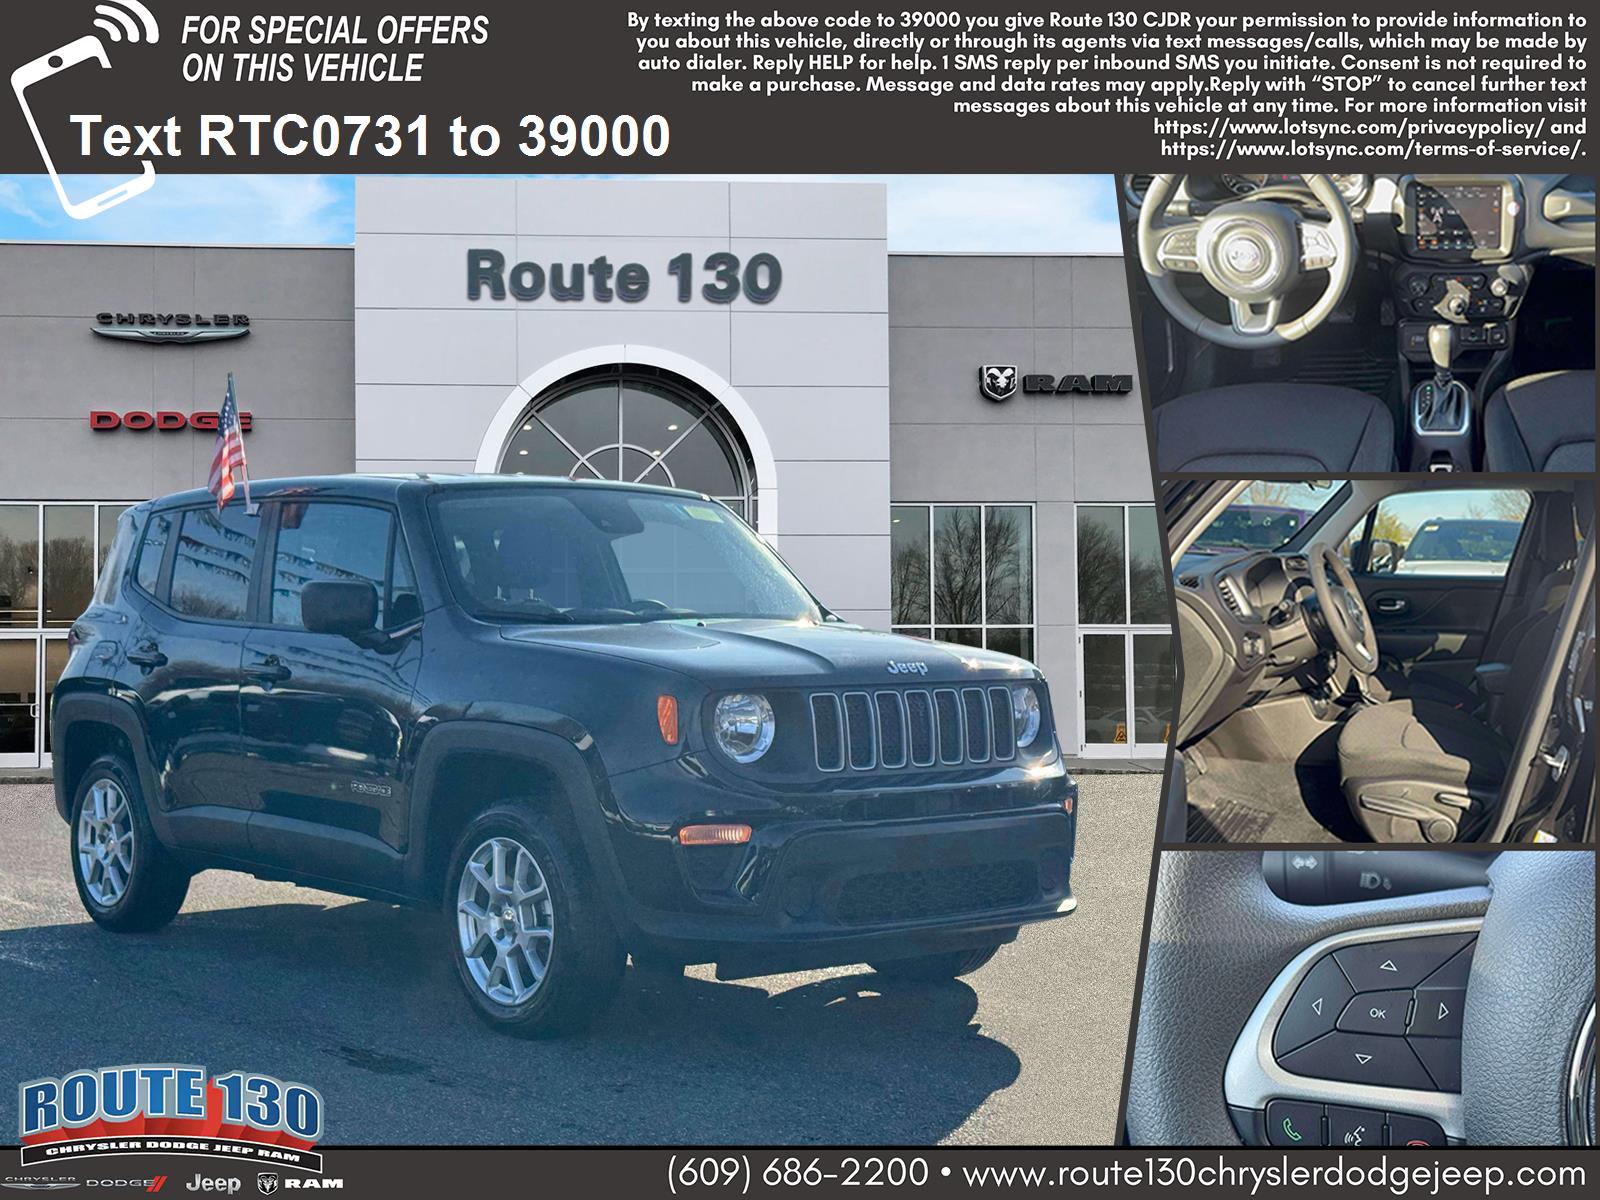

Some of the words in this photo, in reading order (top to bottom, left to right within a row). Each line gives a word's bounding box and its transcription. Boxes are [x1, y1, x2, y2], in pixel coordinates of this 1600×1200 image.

[467, 248, 650, 303] Route
[668, 251, 782, 304] 130
[96, 312, 250, 326] CHRYSLER
[1023, 374, 1133, 393] RAM
[887, 660, 928, 676] Jeep
[1369, 1007, 1386, 1019] OK
